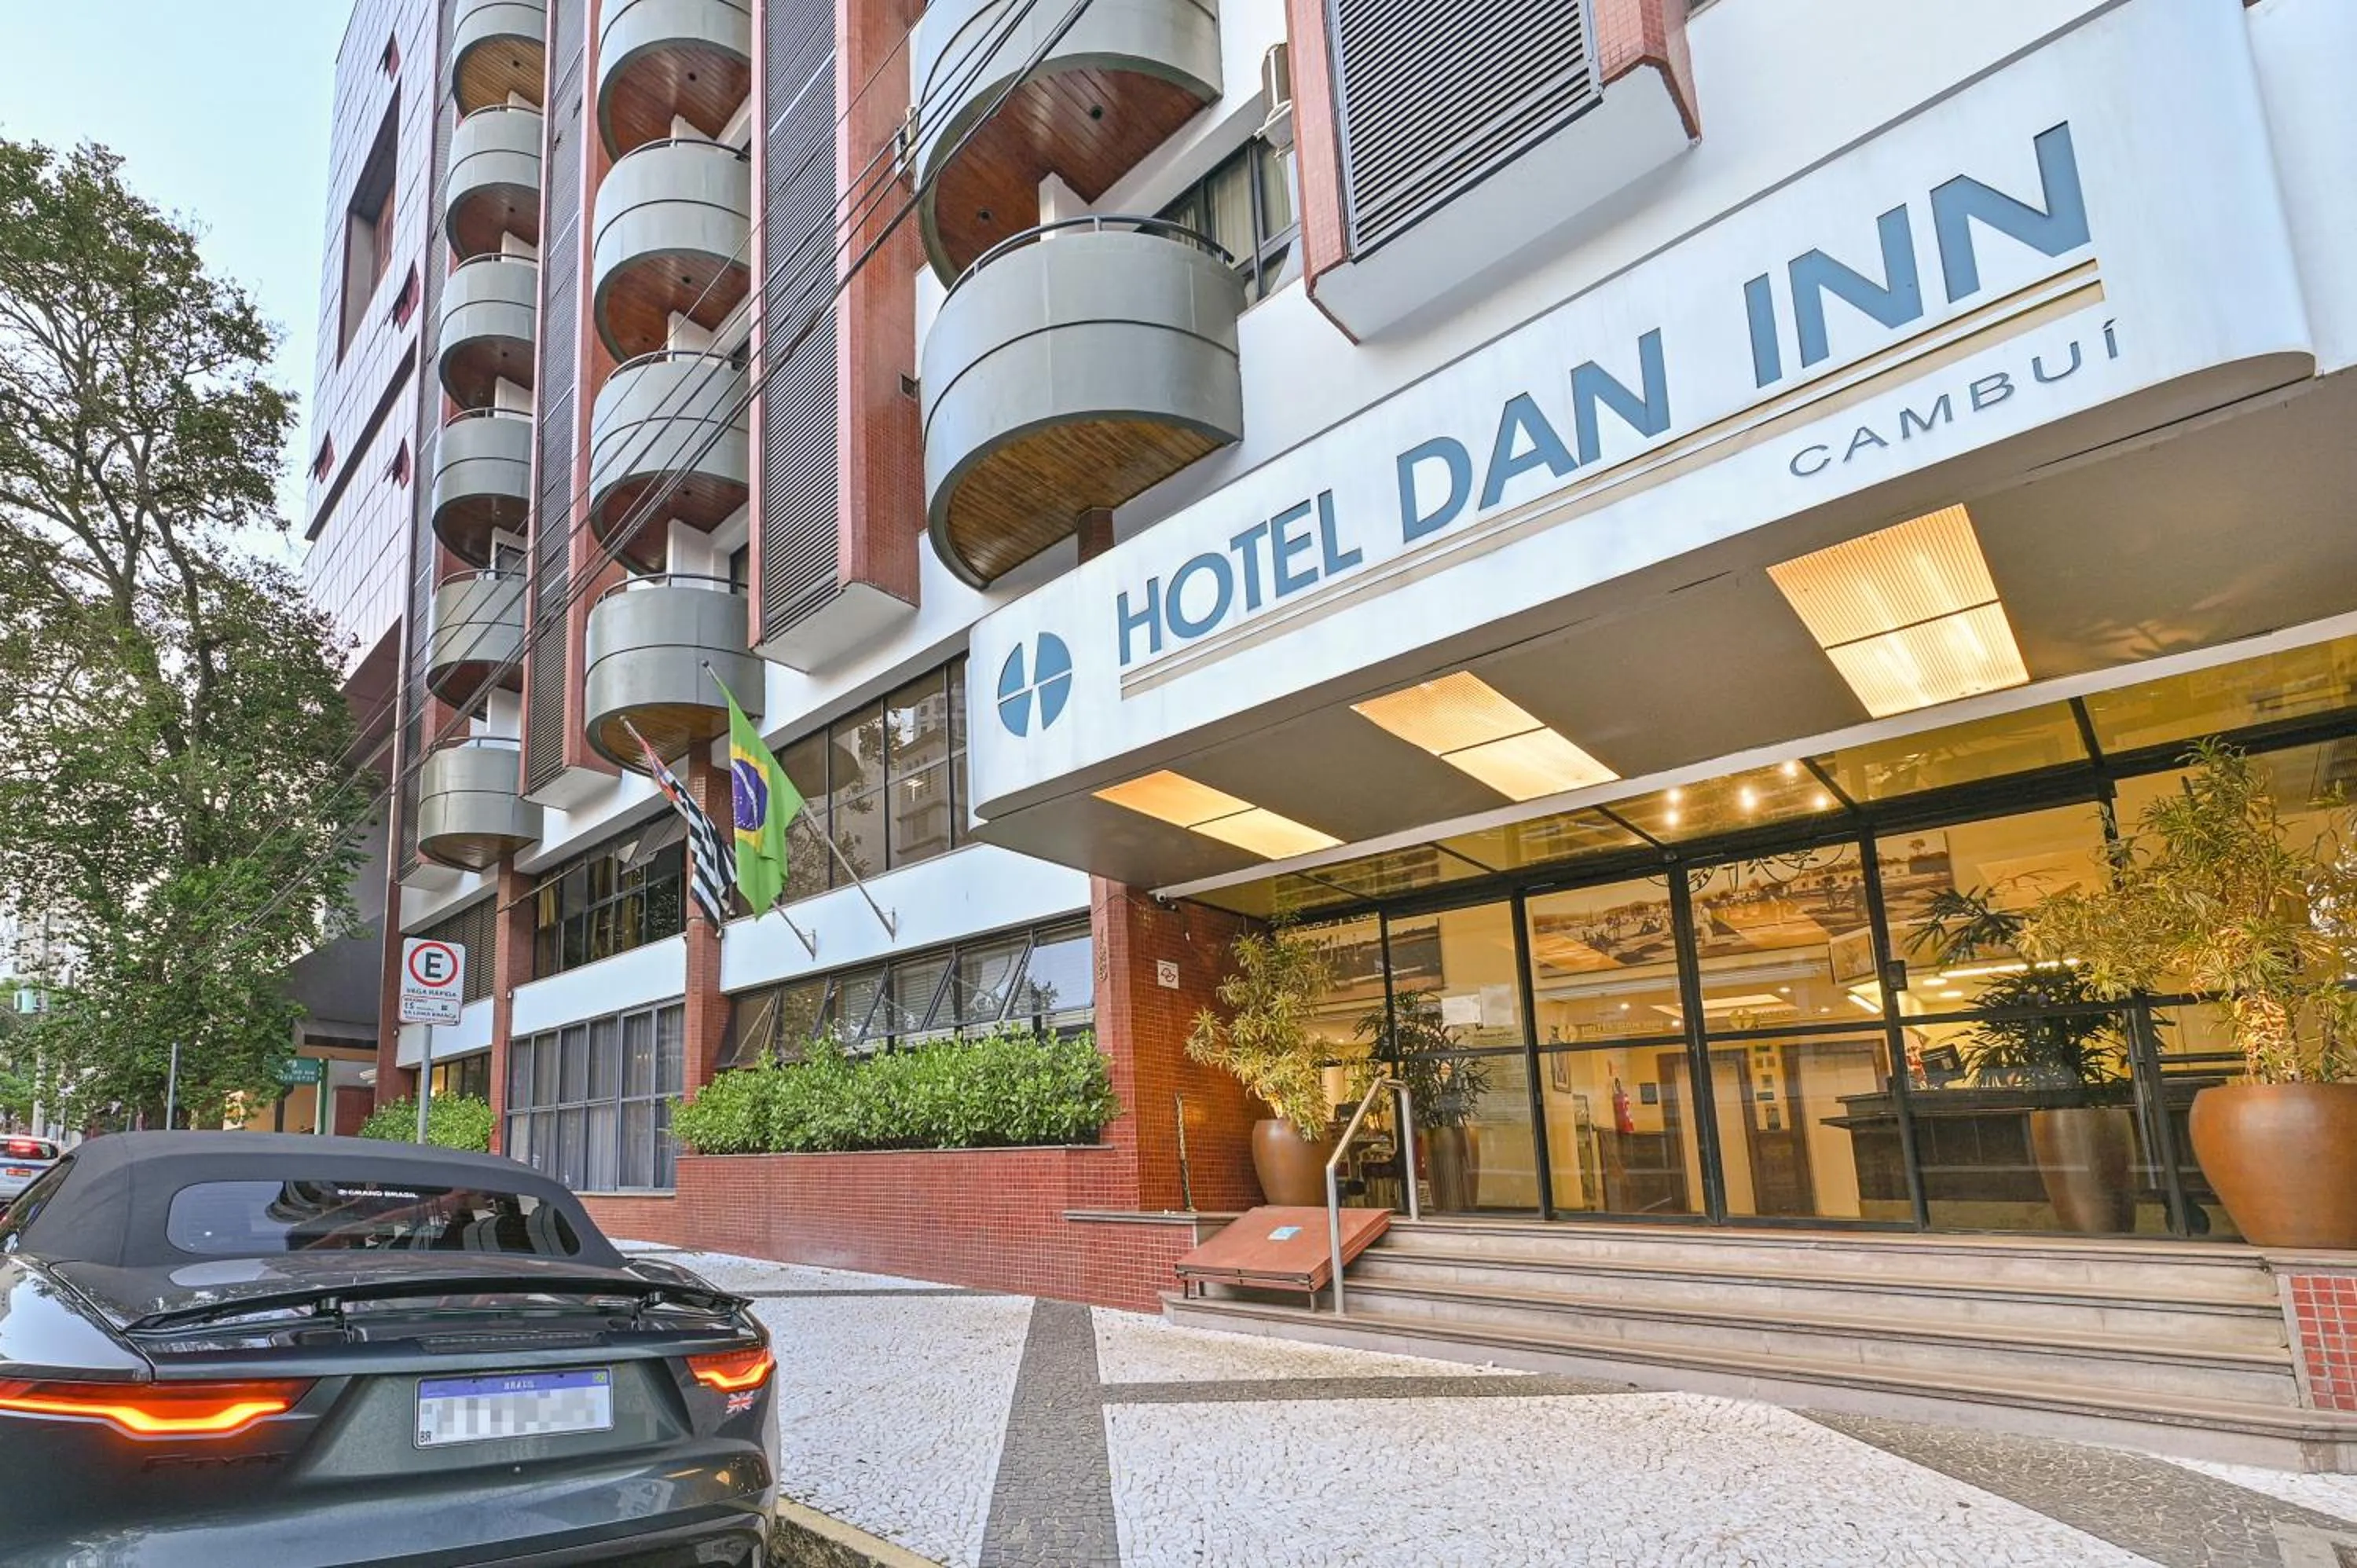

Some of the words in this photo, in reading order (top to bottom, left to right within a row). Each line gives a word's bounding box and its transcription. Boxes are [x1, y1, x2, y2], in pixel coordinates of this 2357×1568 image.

[1116, 490, 1362, 665] HOTEL
[1398, 328, 1670, 543] DAN
[1744, 121, 2091, 389] INN
[1789, 318, 2119, 477] CAMBUÍ
[424, 951, 442, 978] E
